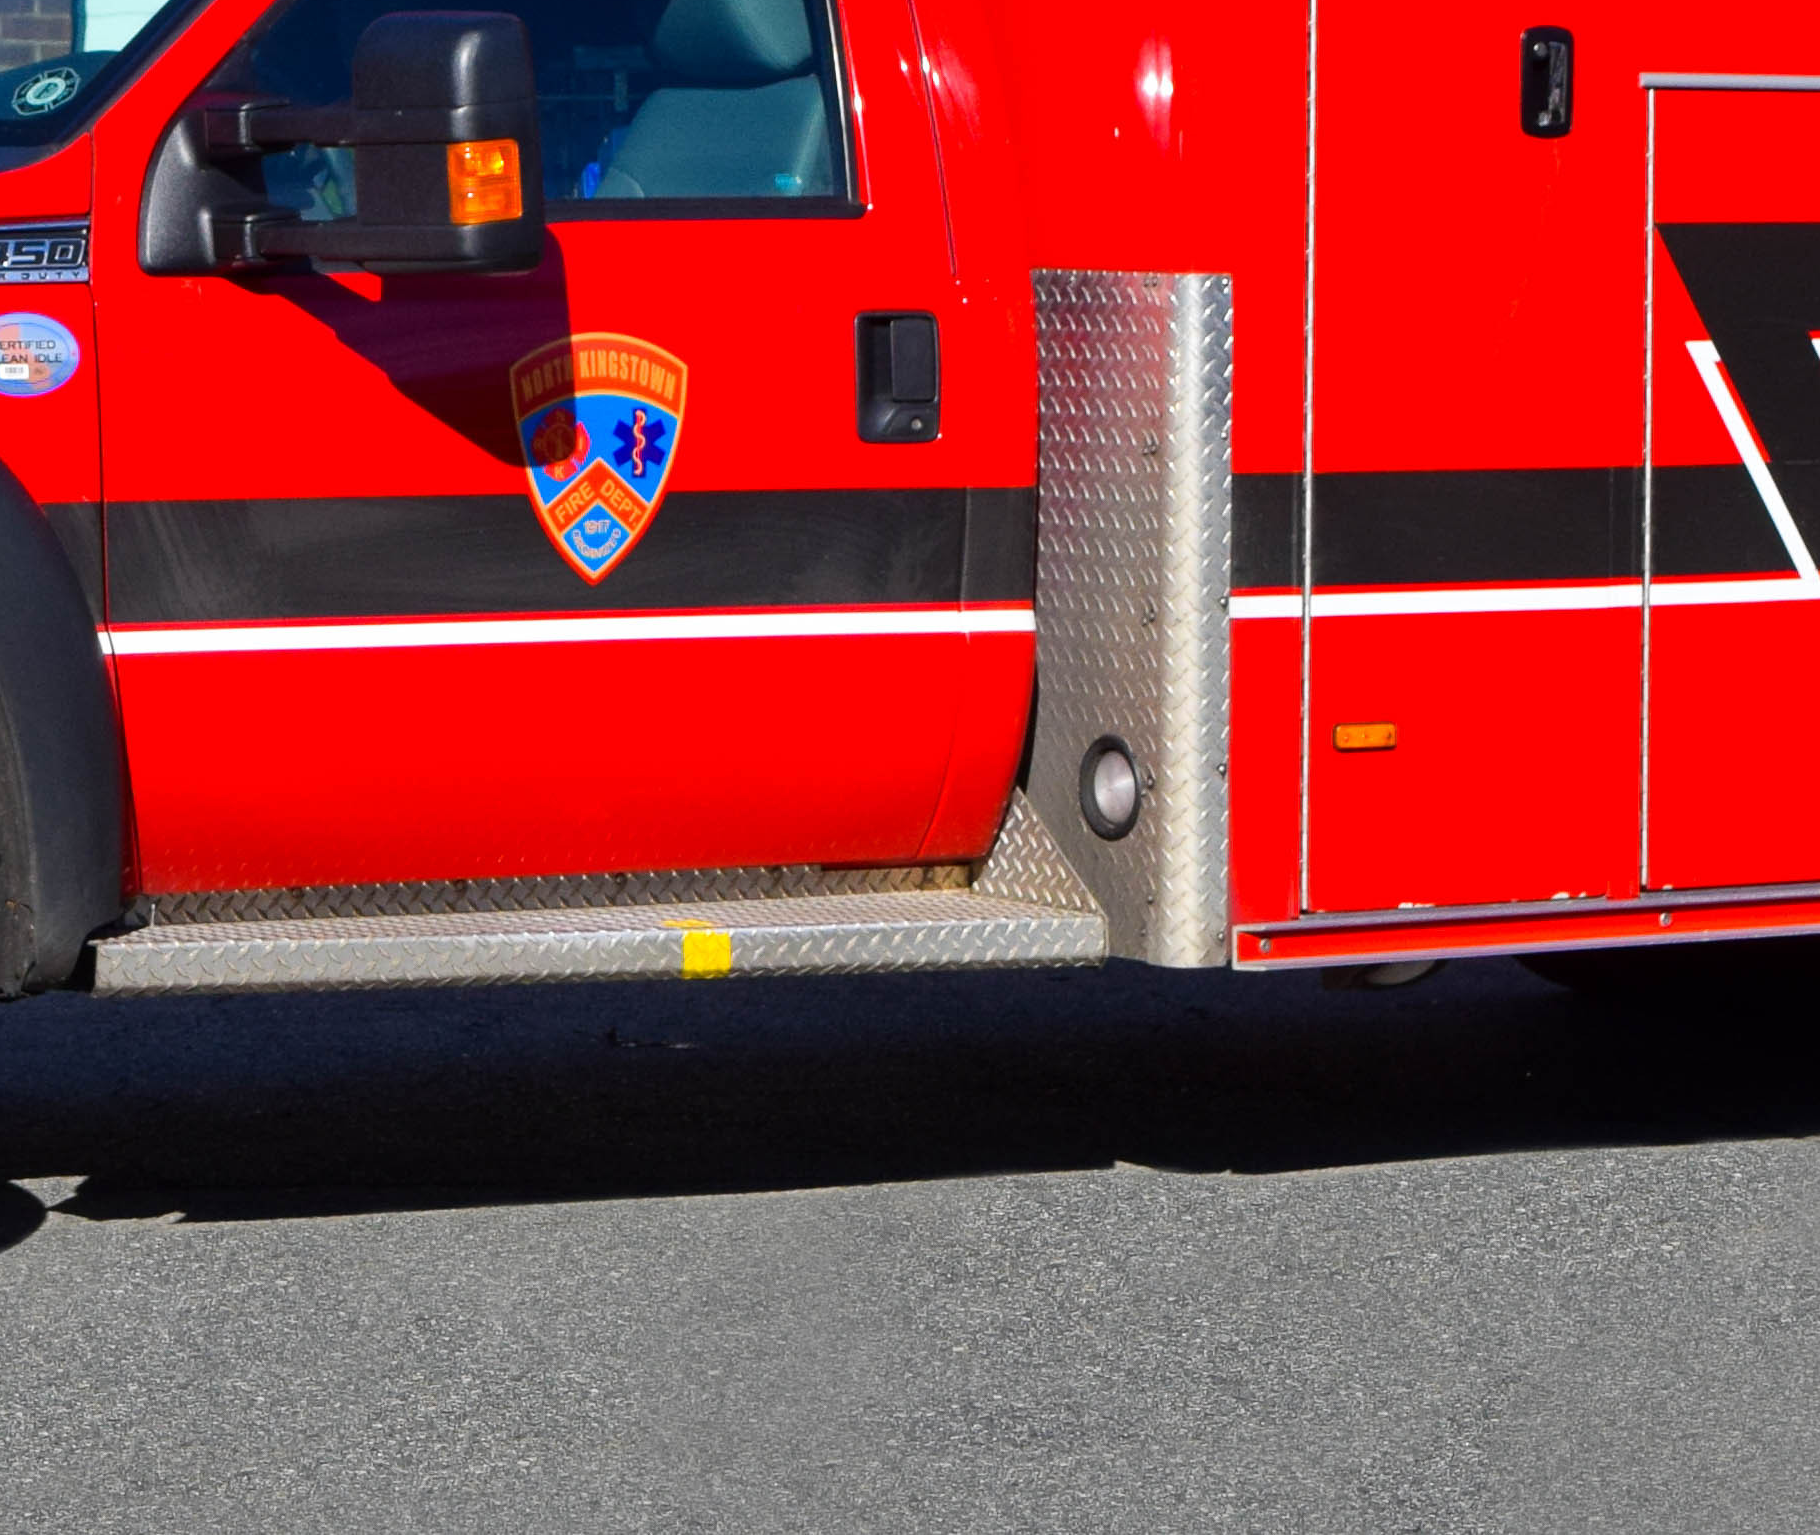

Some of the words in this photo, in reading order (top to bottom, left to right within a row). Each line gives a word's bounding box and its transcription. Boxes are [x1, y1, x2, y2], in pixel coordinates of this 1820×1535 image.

[20, 271, 81, 281] DUTY
[34, 352, 63, 363] IDLE
[521, 352, 575, 402] NORTH
[579, 349, 677, 402] KINGSTOWN
[554, 480, 595, 524] FIRE
